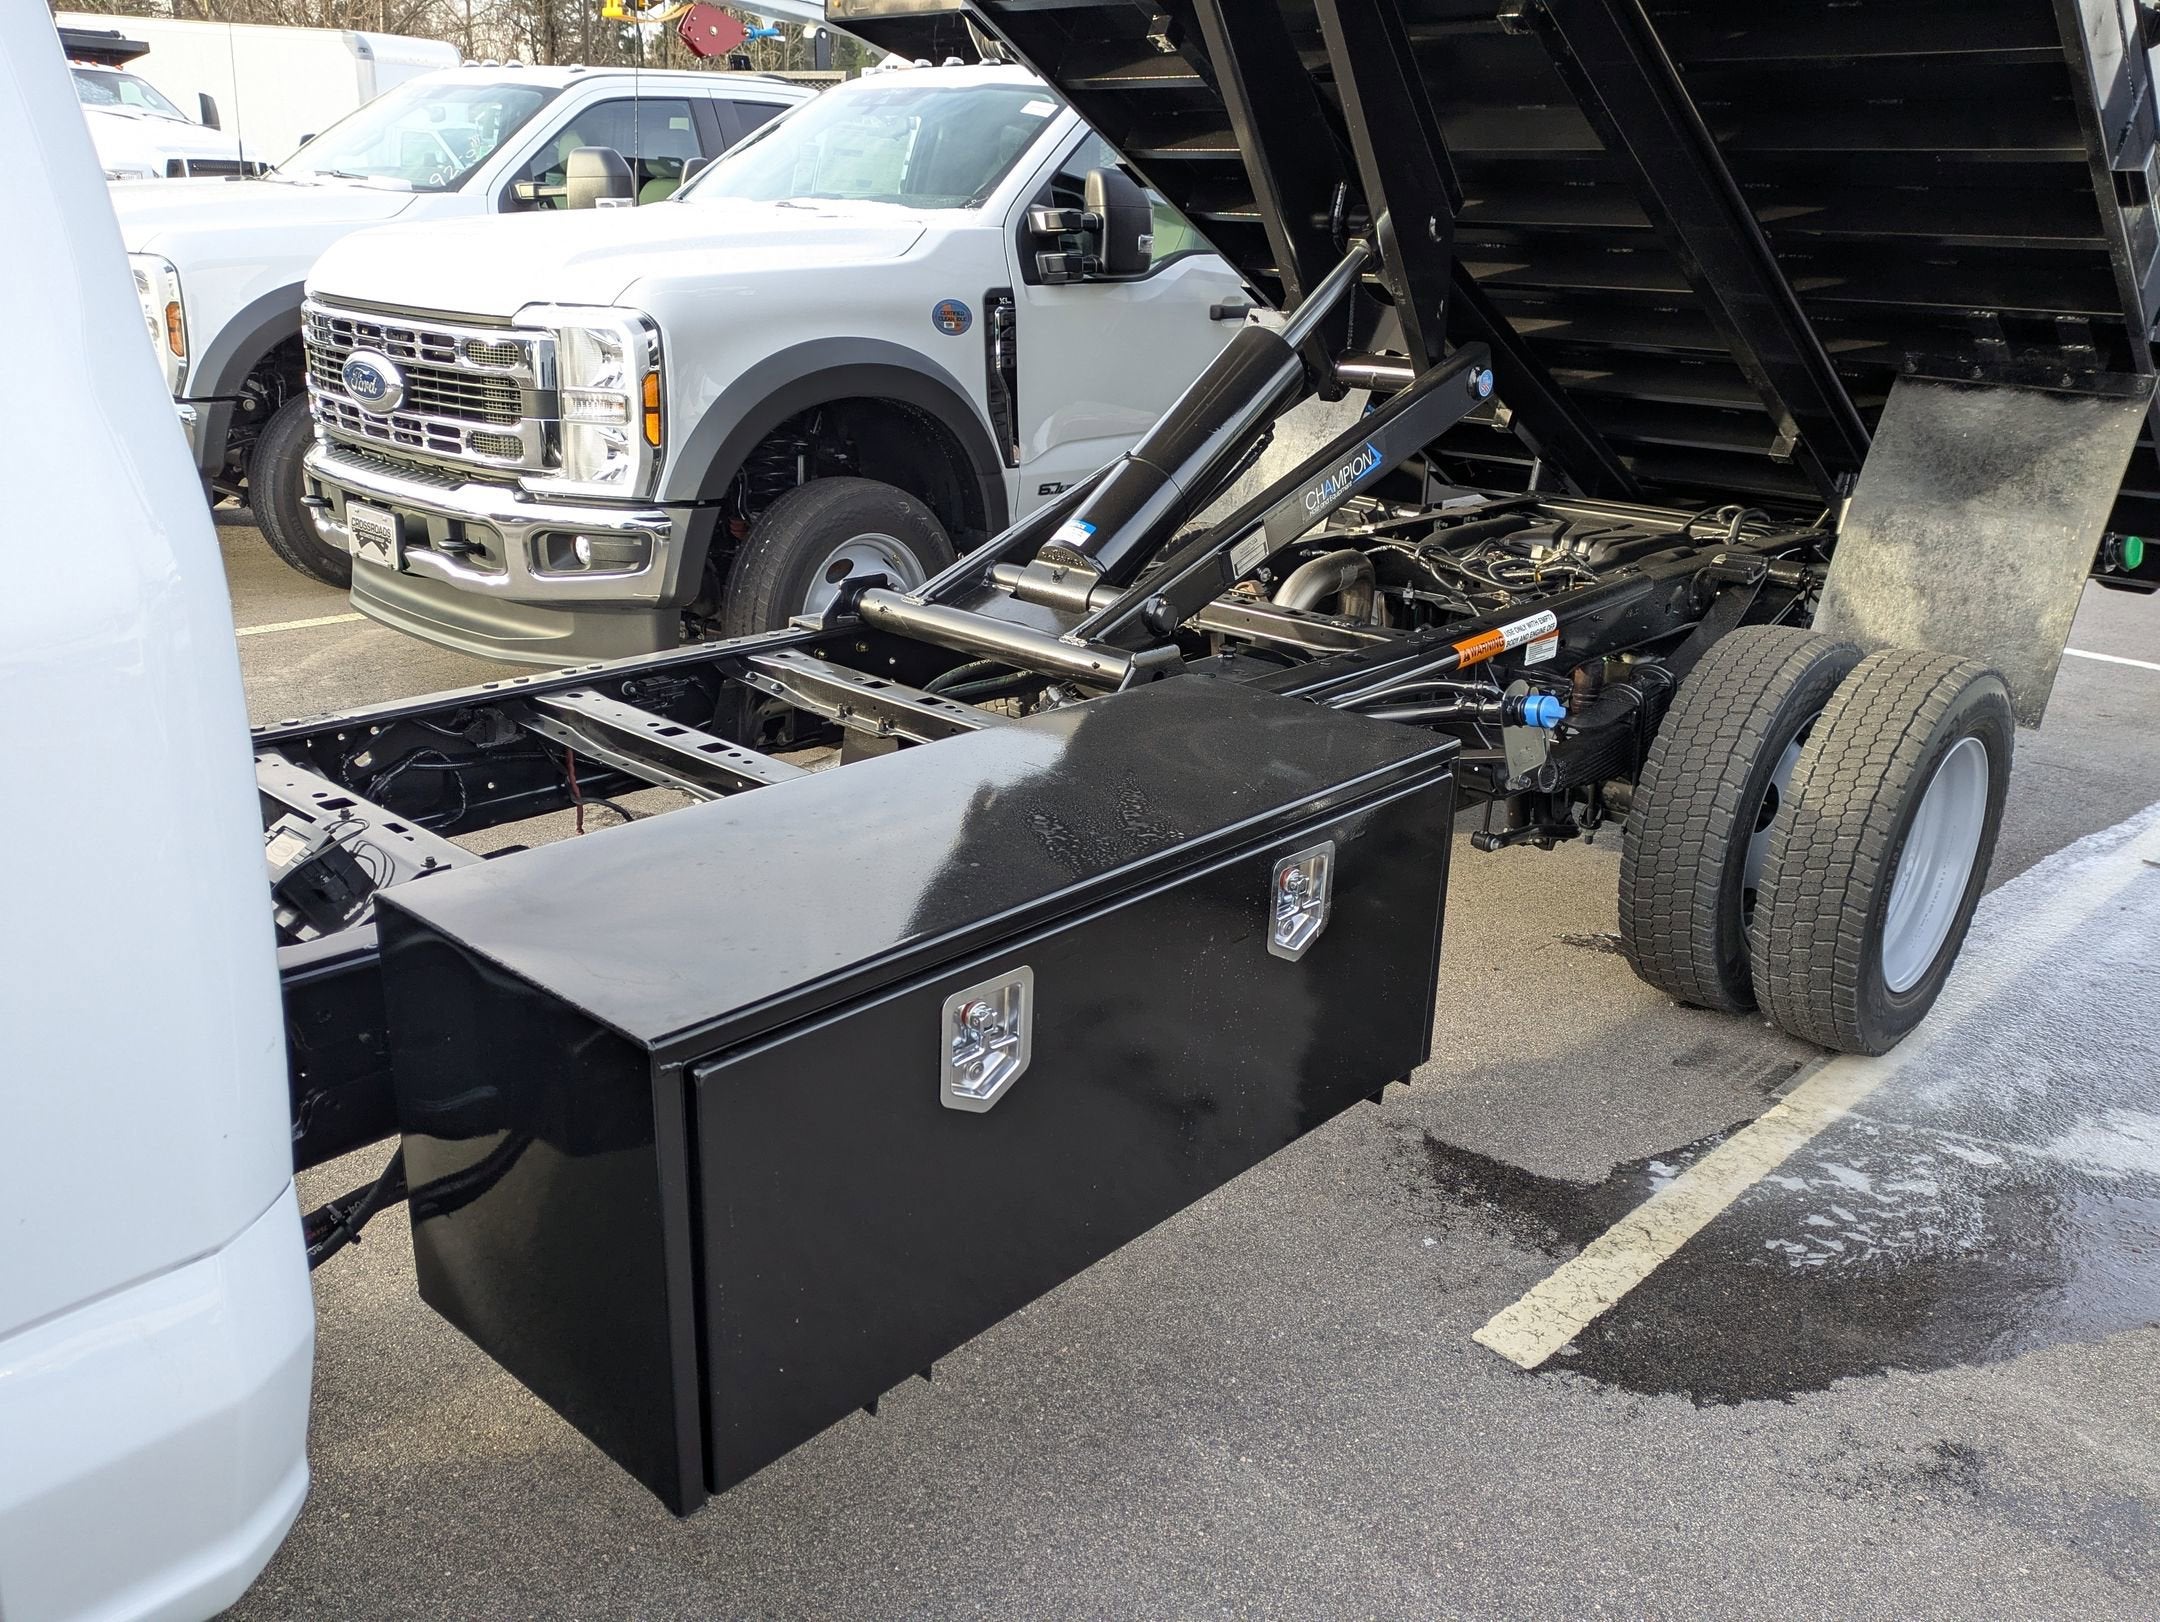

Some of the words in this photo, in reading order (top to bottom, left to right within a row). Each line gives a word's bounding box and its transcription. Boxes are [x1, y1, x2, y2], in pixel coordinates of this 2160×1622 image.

[351, 368, 378, 395] Ford
[1305, 449, 1372, 510] CHAMPION
[1320, 496, 1330, 507] and
[1329, 480, 1353, 501] Equipment
[351, 516, 392, 538] CROSSROADS
[1504, 629, 1515, 637] USE
[1514, 625, 1527, 635] ONLY
[1527, 619, 1539, 630] WITH
[1538, 613, 1554, 626] EMPTY
[1506, 637, 1521, 648] BODY
[1520, 633, 1530, 642] AND
[1529, 626, 1546, 639] ENGINE
[1546, 622, 1556, 632] OFF
[1470, 635, 1505, 658] WARNING
